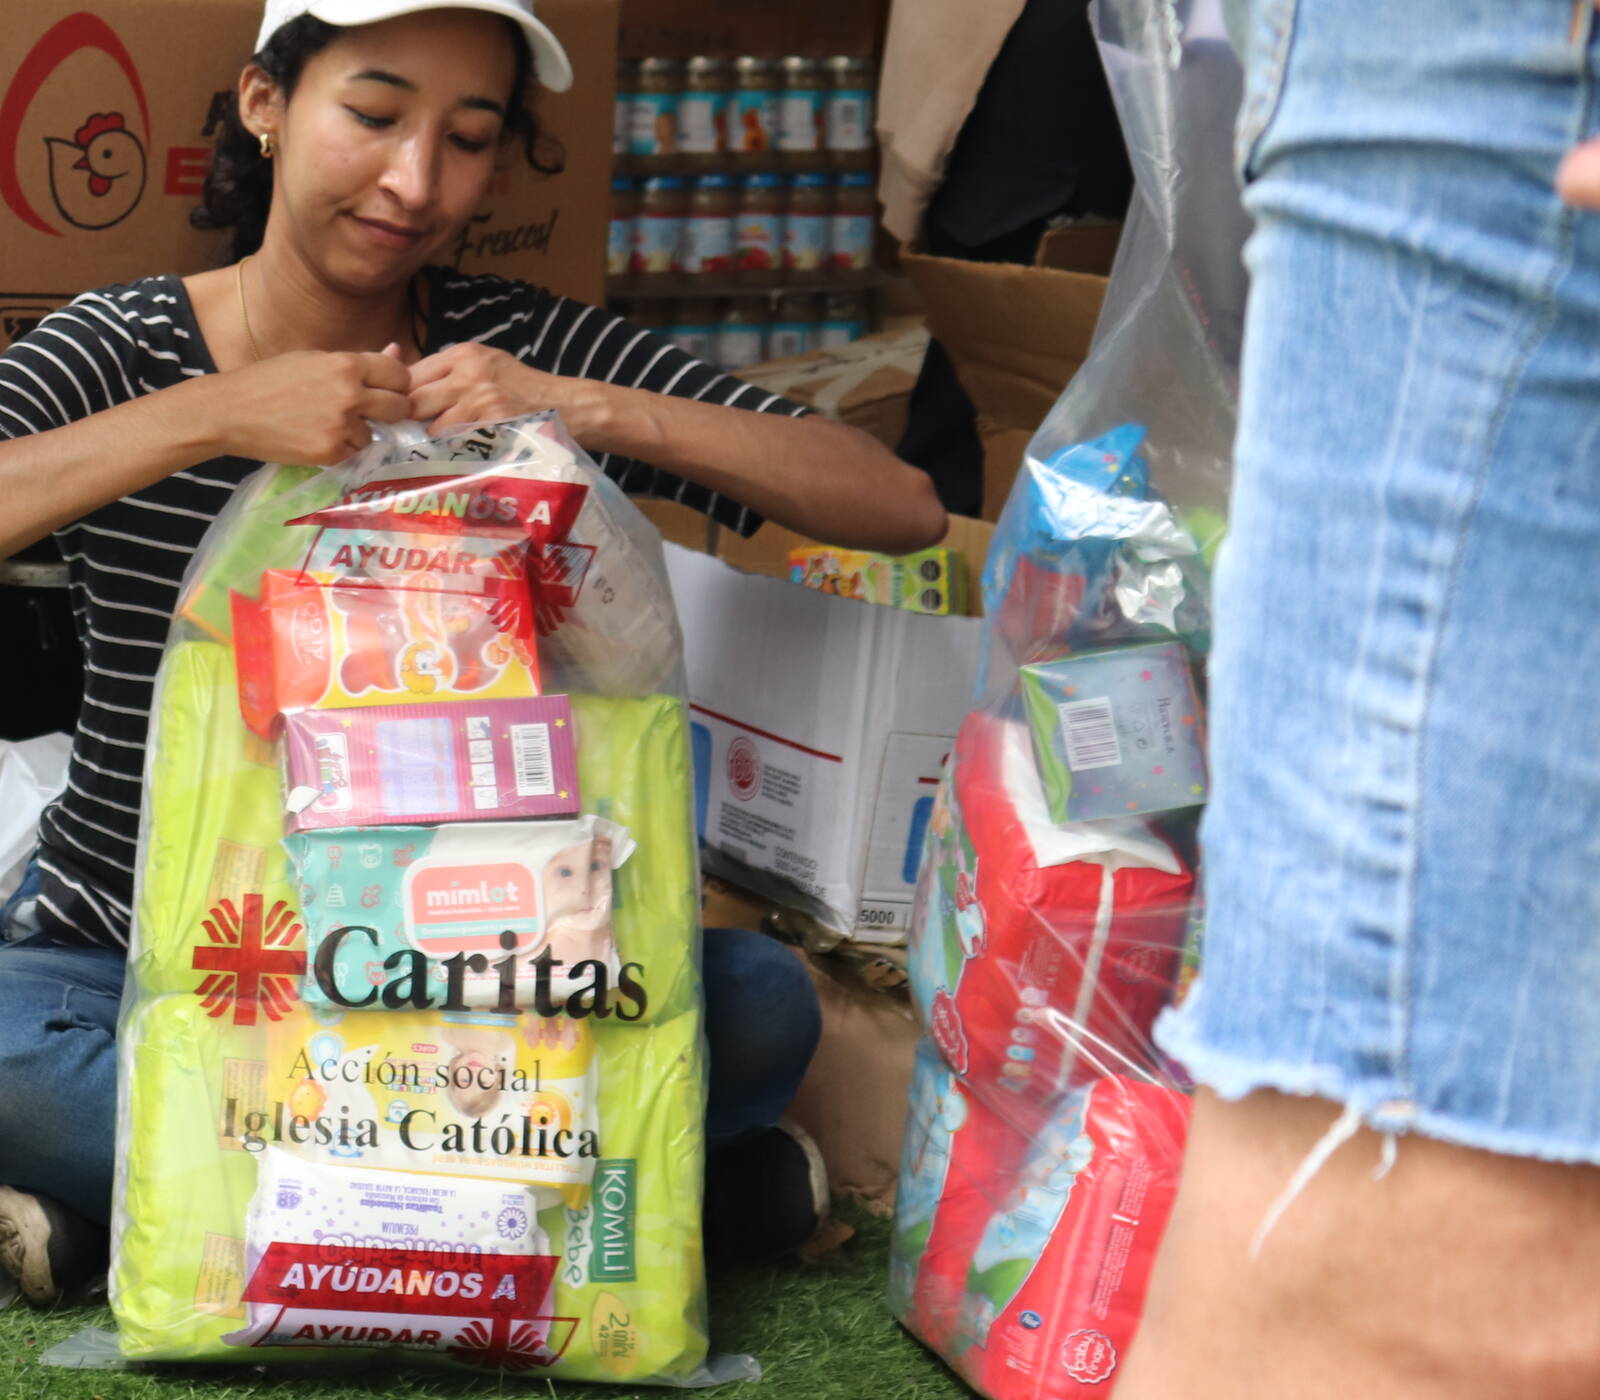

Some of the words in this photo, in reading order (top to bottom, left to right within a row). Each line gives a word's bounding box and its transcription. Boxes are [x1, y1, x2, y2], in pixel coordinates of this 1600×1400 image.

[526, 500, 552, 525] A
[329, 544, 477, 575] AYUDAR
[427, 881, 519, 907] mimlot
[860, 909, 895, 925] 5000
[314, 925, 648, 1022] Caritas
[288, 1048, 424, 1087] Acción
[434, 1060, 542, 1092] social
[223, 1098, 380, 1153] Iglesia
[399, 1109, 601, 1158] Católica
[276, 1191, 302, 1210] 48
[381, 1221, 419, 1235] PREMIUM
[280, 1260, 483, 1298] AYÚDANOS
[491, 1274, 518, 1301] A
[609, 1312, 630, 1328] 2
[292, 1324, 442, 1346] AYUDAR
[1069, 1336, 1095, 1371] baby
